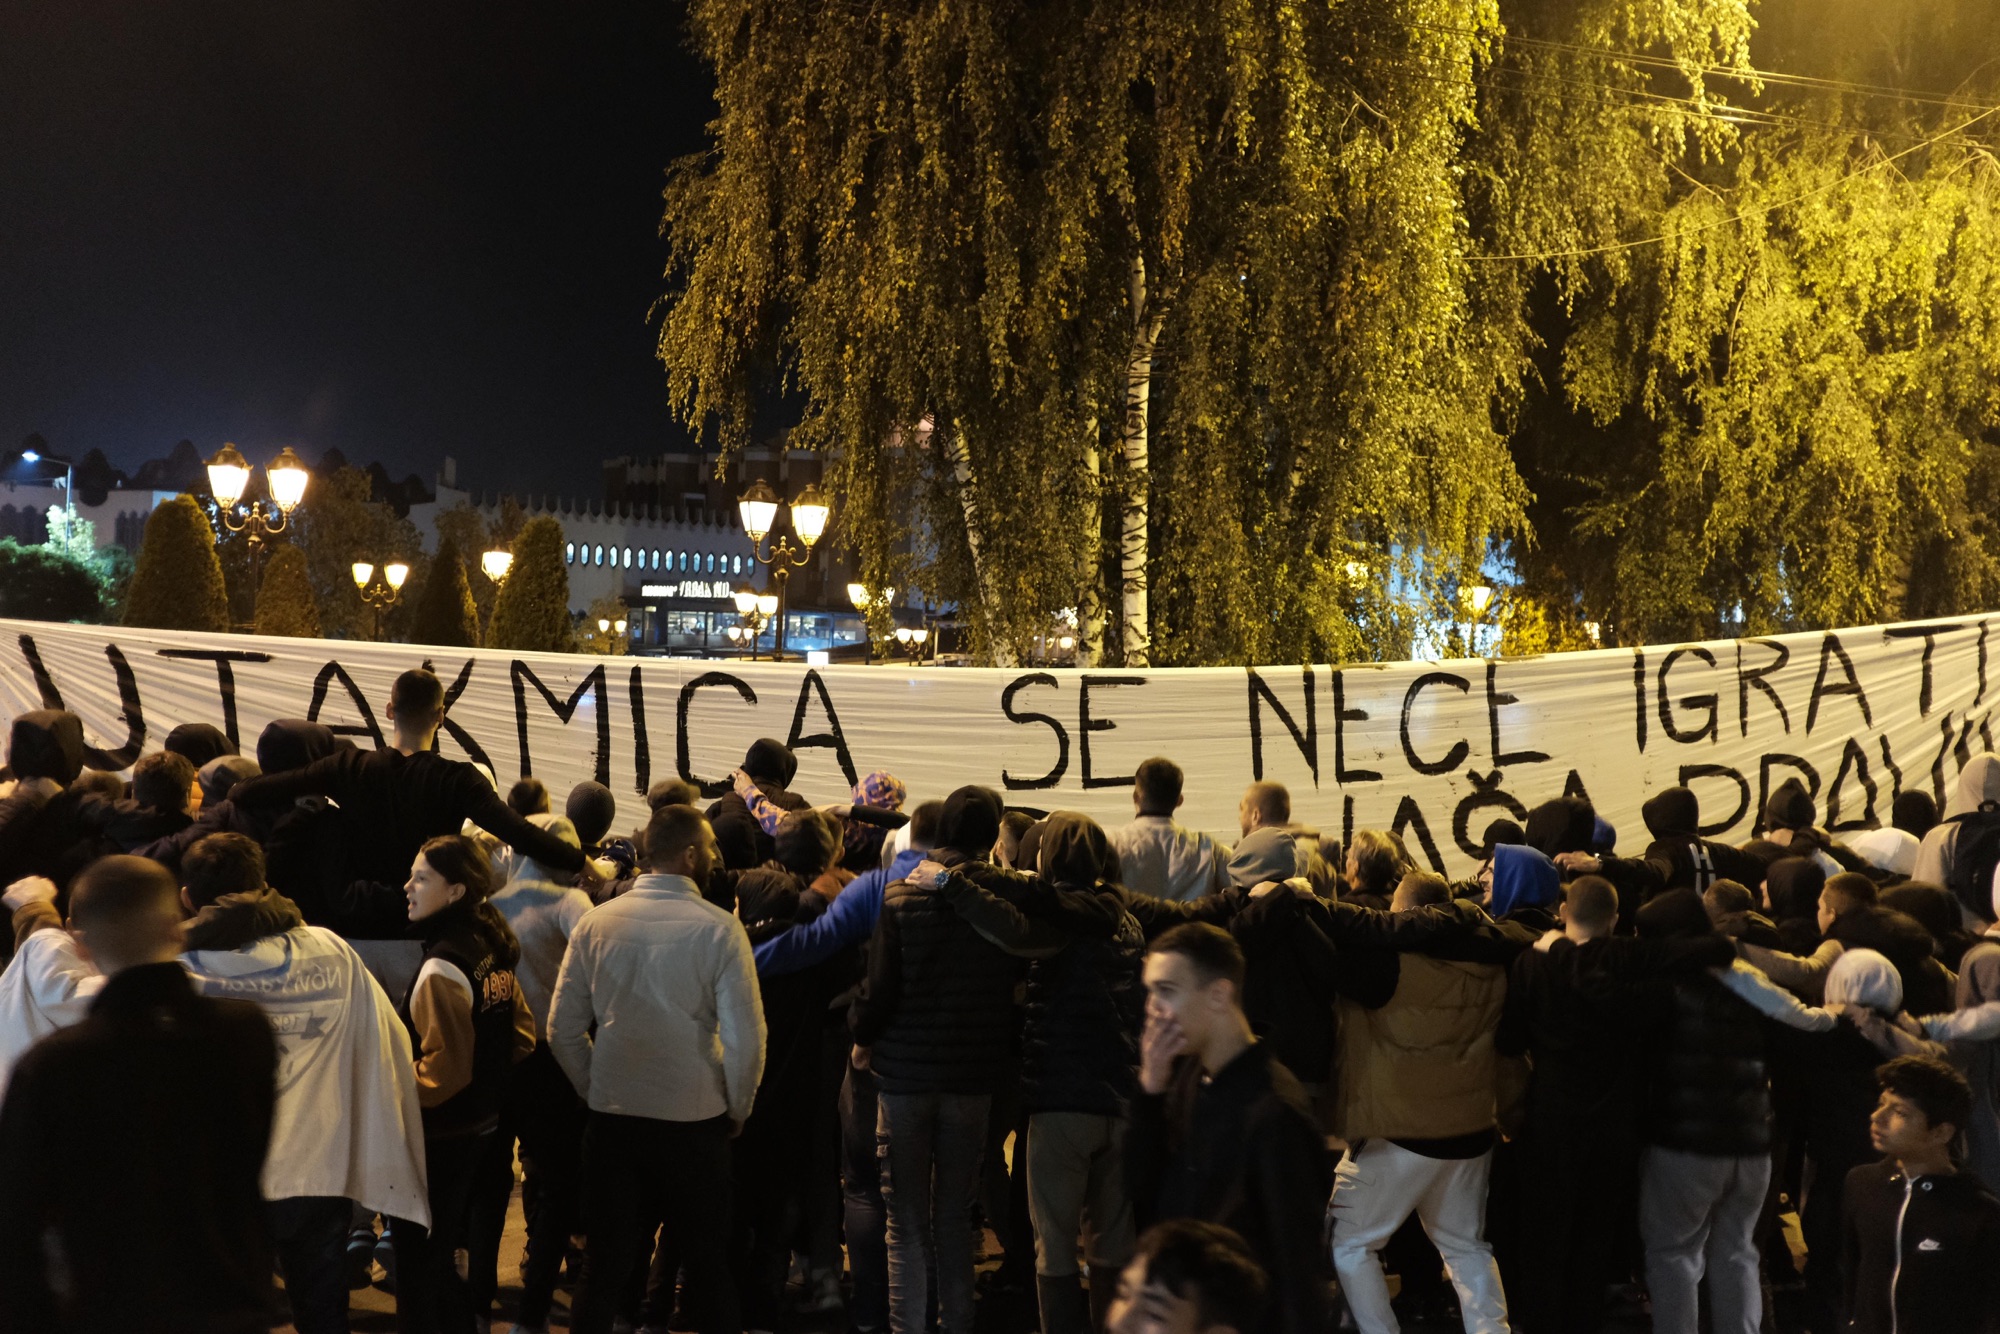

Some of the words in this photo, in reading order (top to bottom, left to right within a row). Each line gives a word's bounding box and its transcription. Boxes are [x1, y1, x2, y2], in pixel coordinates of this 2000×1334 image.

[18, 634, 858, 798] UTAKMICA
[1002, 672, 1148, 790] SE
[1633, 618, 1989, 754] IGRATI
